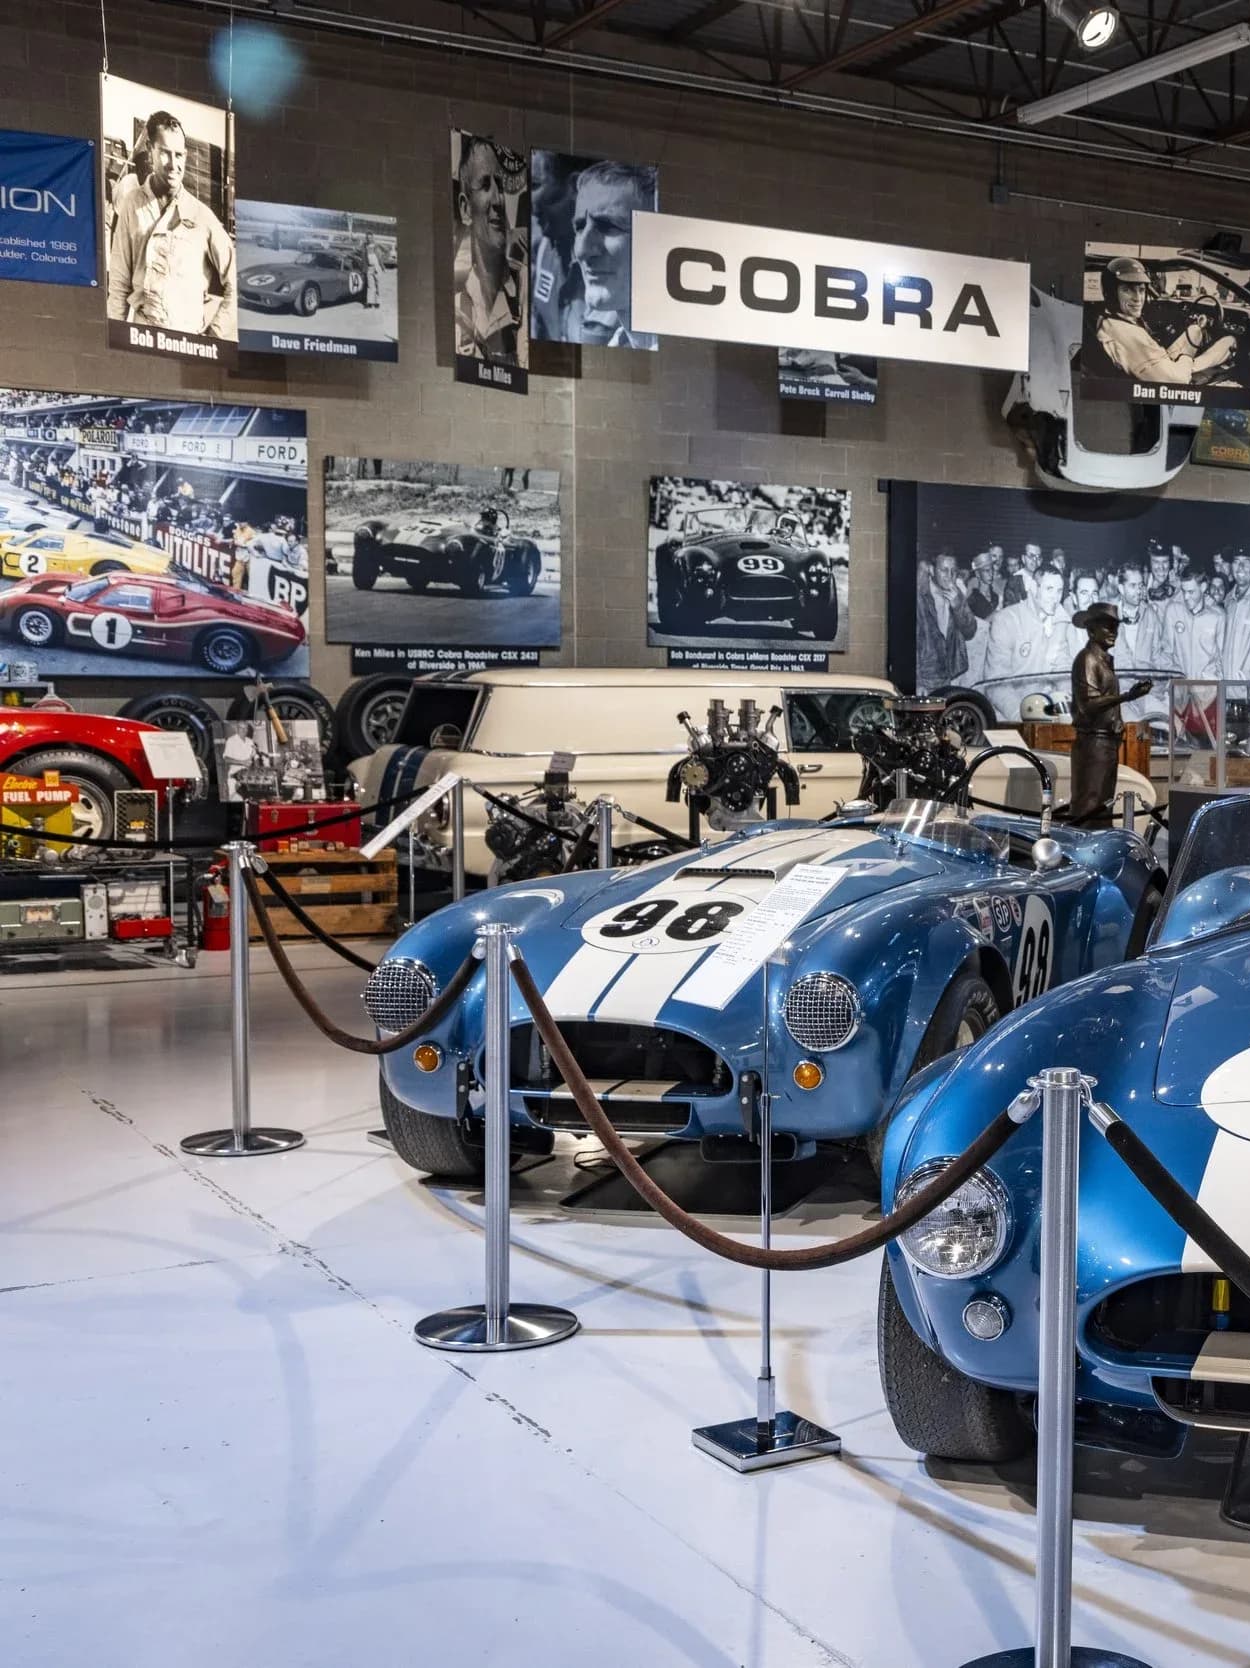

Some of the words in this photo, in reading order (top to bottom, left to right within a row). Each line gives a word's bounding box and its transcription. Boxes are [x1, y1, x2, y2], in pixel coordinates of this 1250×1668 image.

[1, 186, 76, 217] ION
[50, 240, 77, 252] 1996
[31, 251, 77, 265] Colorado
[666, 247, 1000, 338] COBRA
[129, 327, 153, 347] Bob
[157, 332, 219, 360] Bondurant
[271, 335, 301, 350] Dave
[304, 338, 358, 355] Friedman
[478, 363, 492, 380] Ken
[493, 366, 512, 384] Miles
[780, 383, 797, 395] Pete
[824, 387, 850, 399] Carroll
[852, 390, 875, 403] Shelby
[1133, 383, 1156, 399] Dan
[1159, 385, 1202, 404] Gurney
[181, 440, 207, 454] FORD
[257, 444, 298, 461] FORD
[27, 554, 39, 574] 2
[742, 558, 779, 571] 99
[272, 575, 307, 617] BP
[105, 617, 117, 645] 1
[354, 648, 371, 658] Ken
[373, 648, 395, 659] Miles
[397, 649, 405, 659] in
[407, 649, 434, 659] USRRC
[437, 649, 462, 660] Cobra
[464, 650, 499, 660] Roadster
[501, 651, 518, 661] CSX
[671, 650, 683, 660] Bob
[685, 650, 716, 660] Bondurant
[717, 651, 724, 660] in
[726, 651, 745, 661] Cobra
[771, 652, 797, 662] Roadster
[799, 653, 811, 662] CSX
[407, 661, 417, 670] at
[419, 661, 455, 671] Riverside
[457, 661, 466, 671] in
[3, 791, 31, 803] FUEL
[36, 790, 72, 803] PUMP
[600, 899, 744, 942] 98
